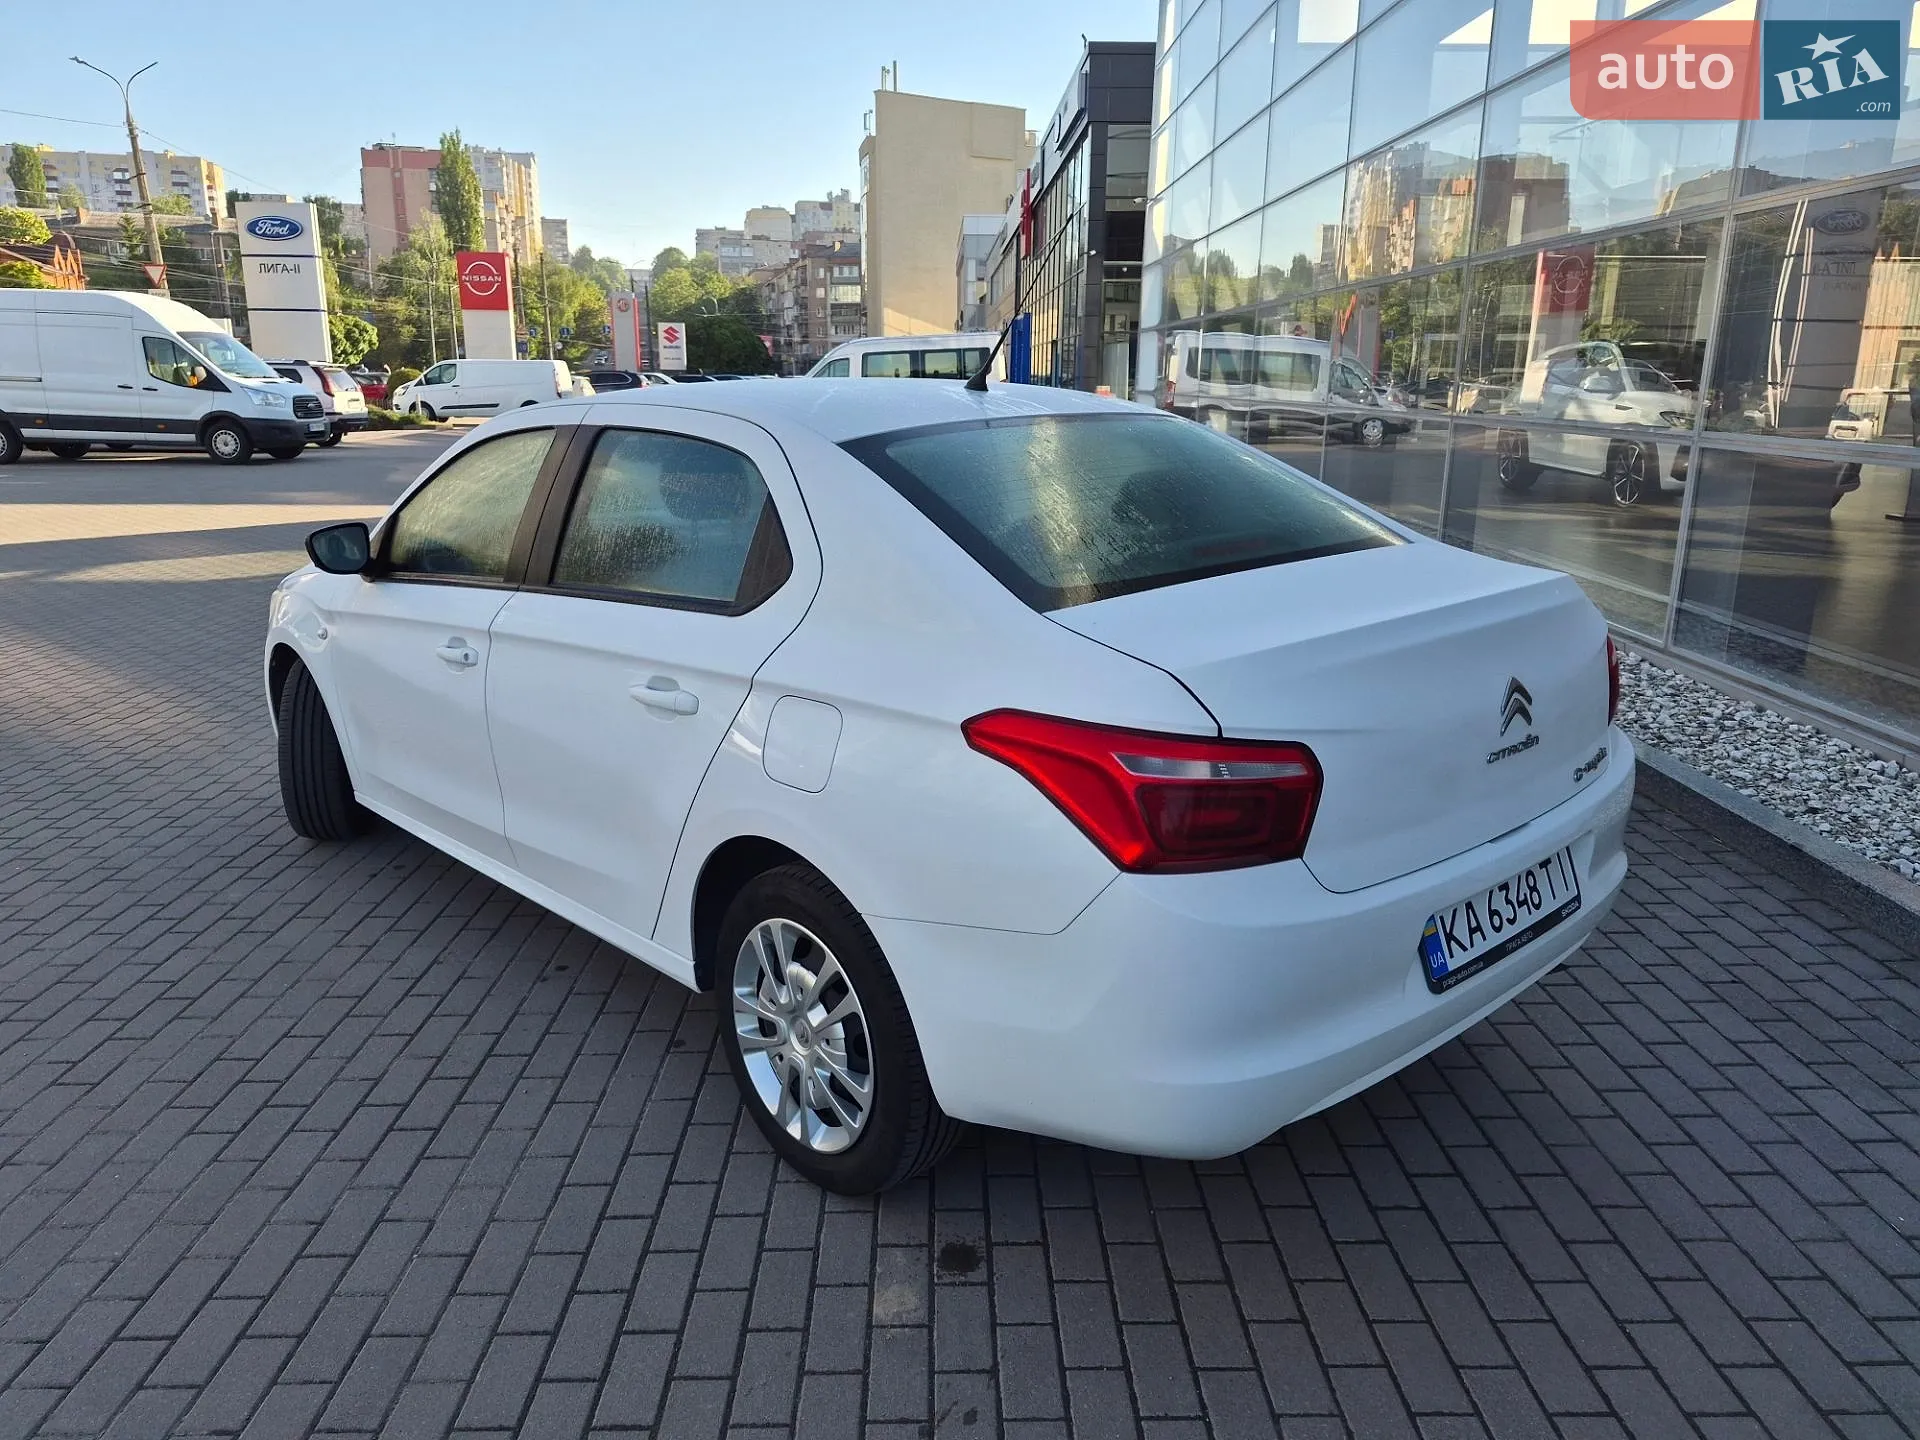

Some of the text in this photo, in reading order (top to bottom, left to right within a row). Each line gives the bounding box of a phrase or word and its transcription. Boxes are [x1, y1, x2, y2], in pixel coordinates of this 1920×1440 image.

[255, 219, 290, 235] Ford
[258, 263, 301, 274] ЛИГА-II
[461, 274, 502, 283] NISSAN
[1438, 900, 1487, 959] KA
[1487, 869, 1543, 934] 6348
[1430, 952, 1445, 968] UA
